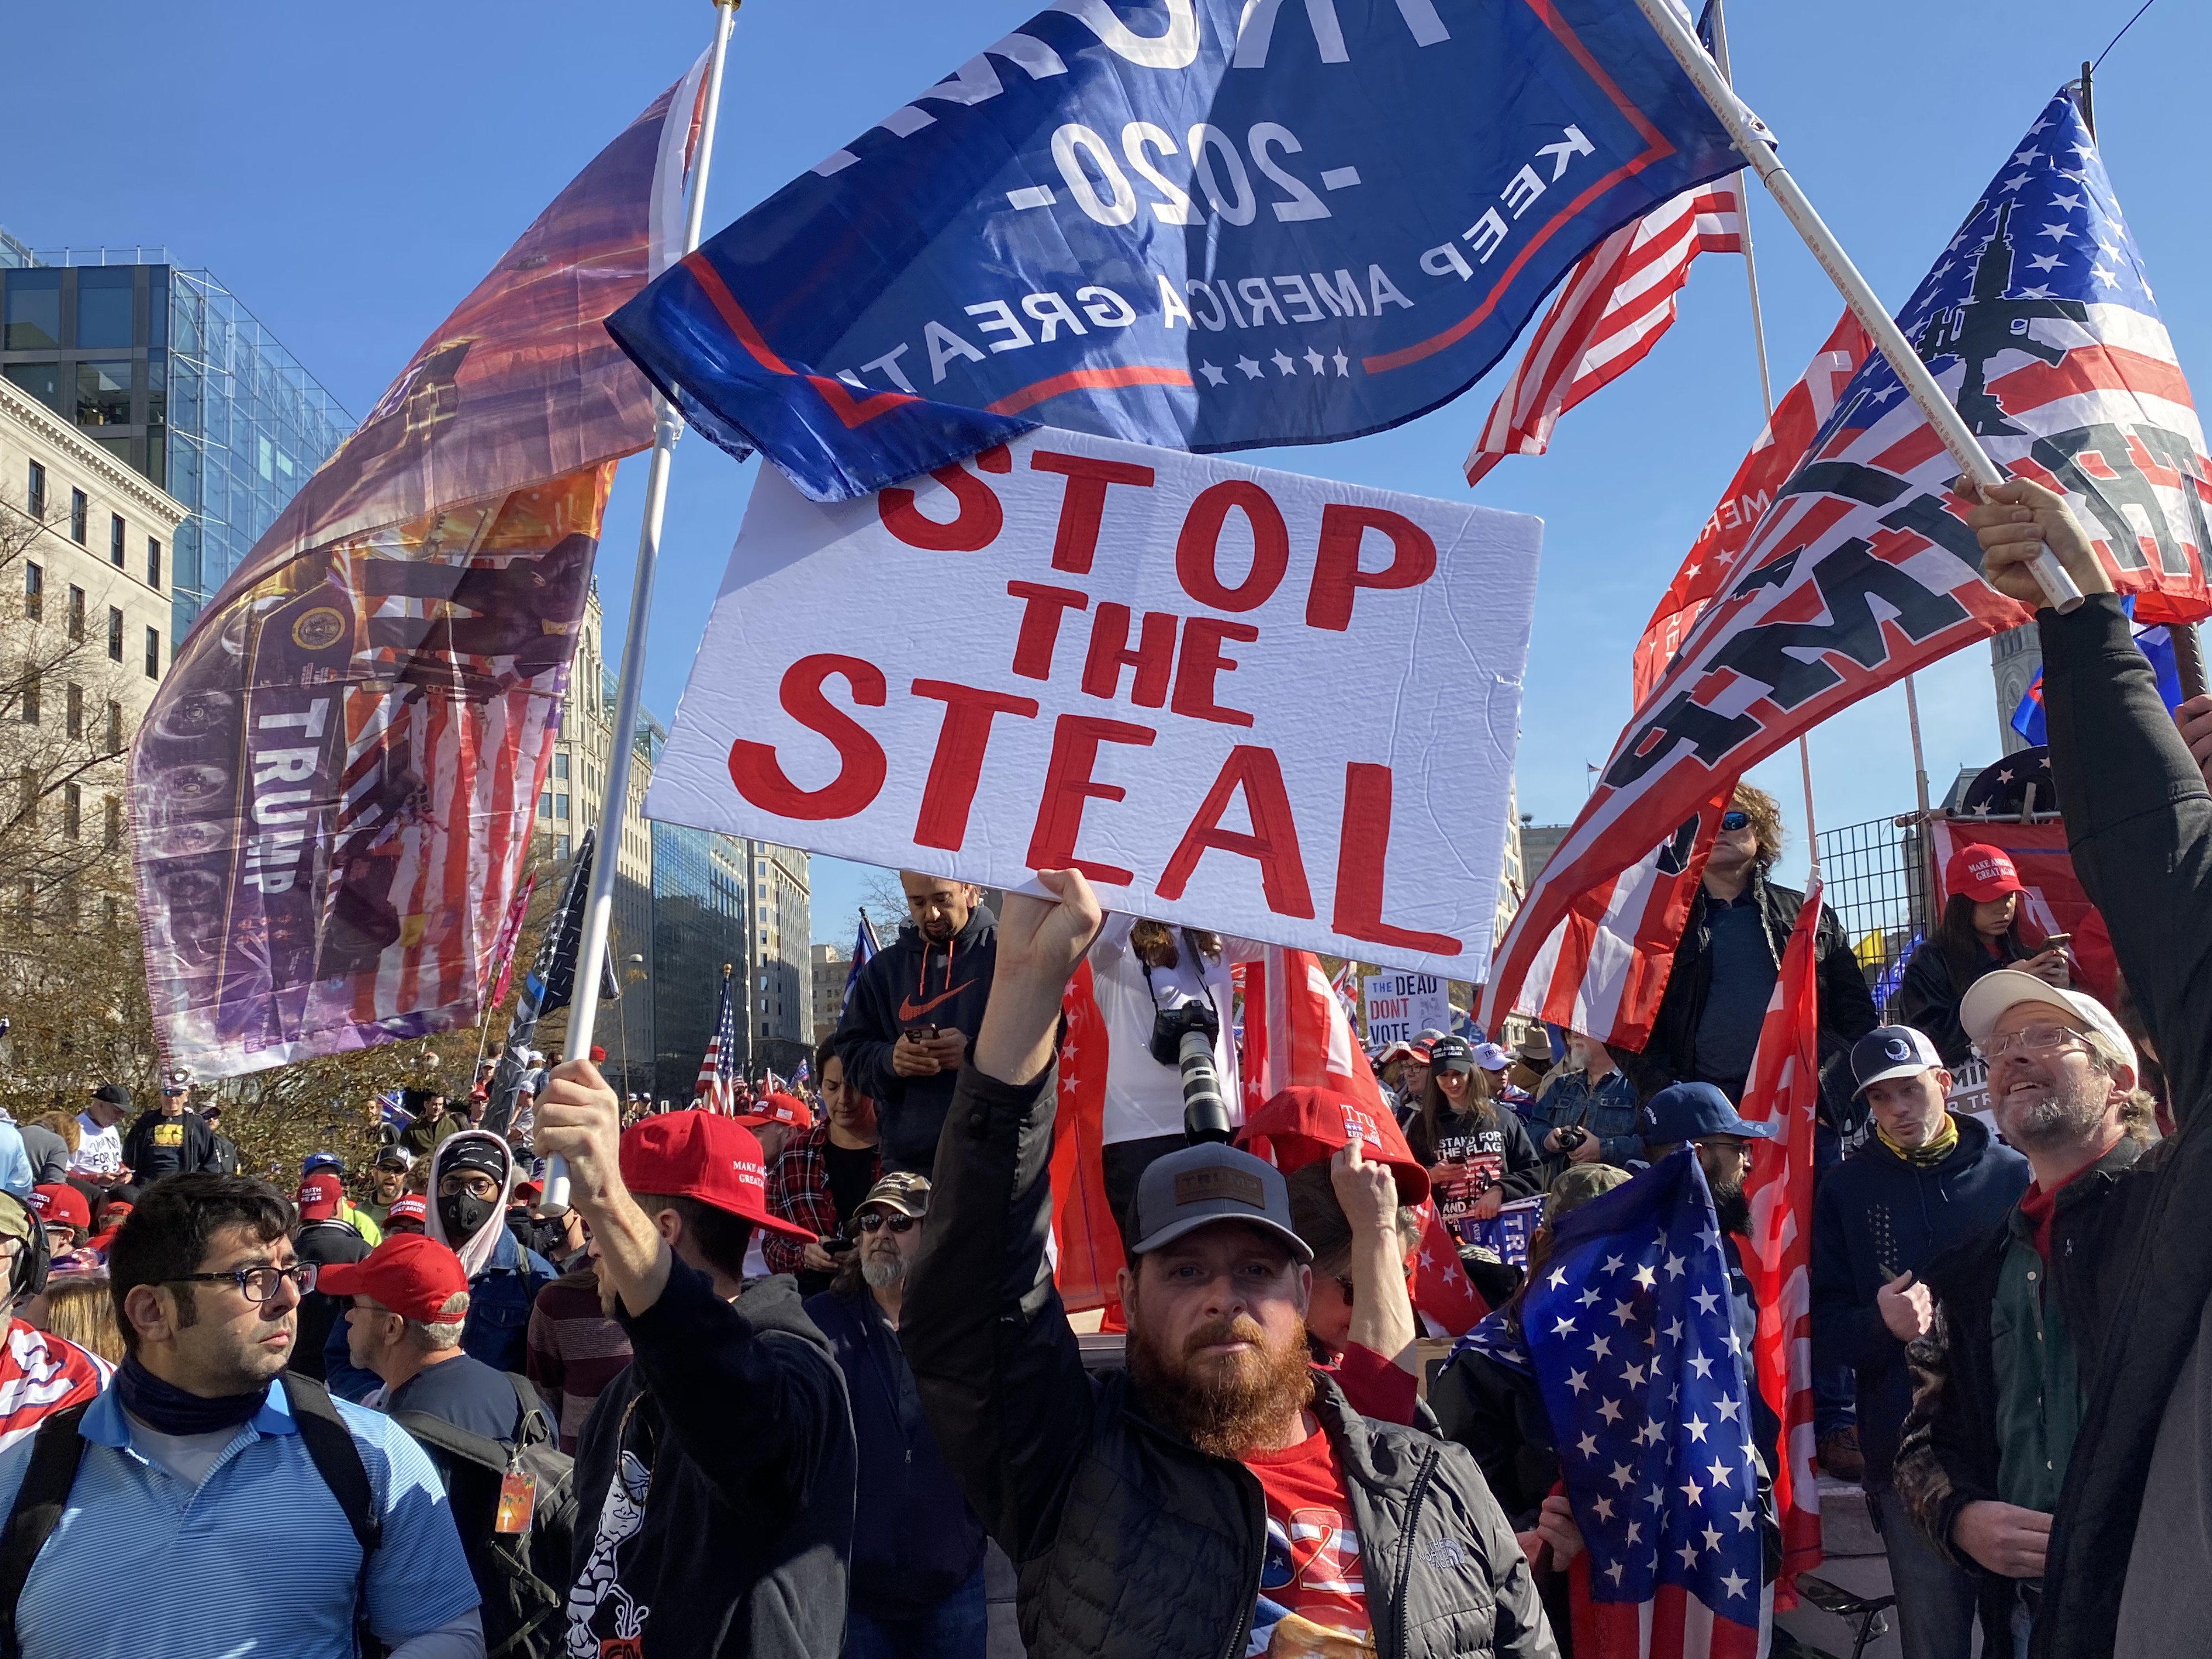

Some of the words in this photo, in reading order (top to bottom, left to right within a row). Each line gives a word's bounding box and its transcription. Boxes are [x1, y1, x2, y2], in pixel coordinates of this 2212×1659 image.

[879, 443, 1436, 631] STOP
[1007, 580, 1259, 728] THE
[243, 698, 330, 894] TRUMP
[728, 653, 1463, 956] STEAL
[1968, 860, 1990, 873] MAKE
[1976, 867, 2000, 881] GREAT
[1372, 981, 1392, 994] THE
[1395, 975, 1437, 996] DEAD
[1369, 997, 1409, 1020] DONT
[1369, 1023, 1411, 1045] VOTE
[1439, 1136, 1475, 1149] STAND
[1479, 1131, 1502, 1142] FOR
[1433, 1147, 1460, 1161] THE
[1465, 1142, 1502, 1156] FLAG
[733, 1160, 757, 1172] MAKE
[739, 1173, 761, 1187] GREAT
[1181, 1172, 1258, 1189] TRUMP
[1443, 1201, 1466, 1214] AND
[1471, 1223, 1481, 1243] KEEP
[1426, 1538, 1444, 1551] THE
[1418, 1547, 1449, 1563] NORTH
[1430, 1558, 1452, 1570] FACE
